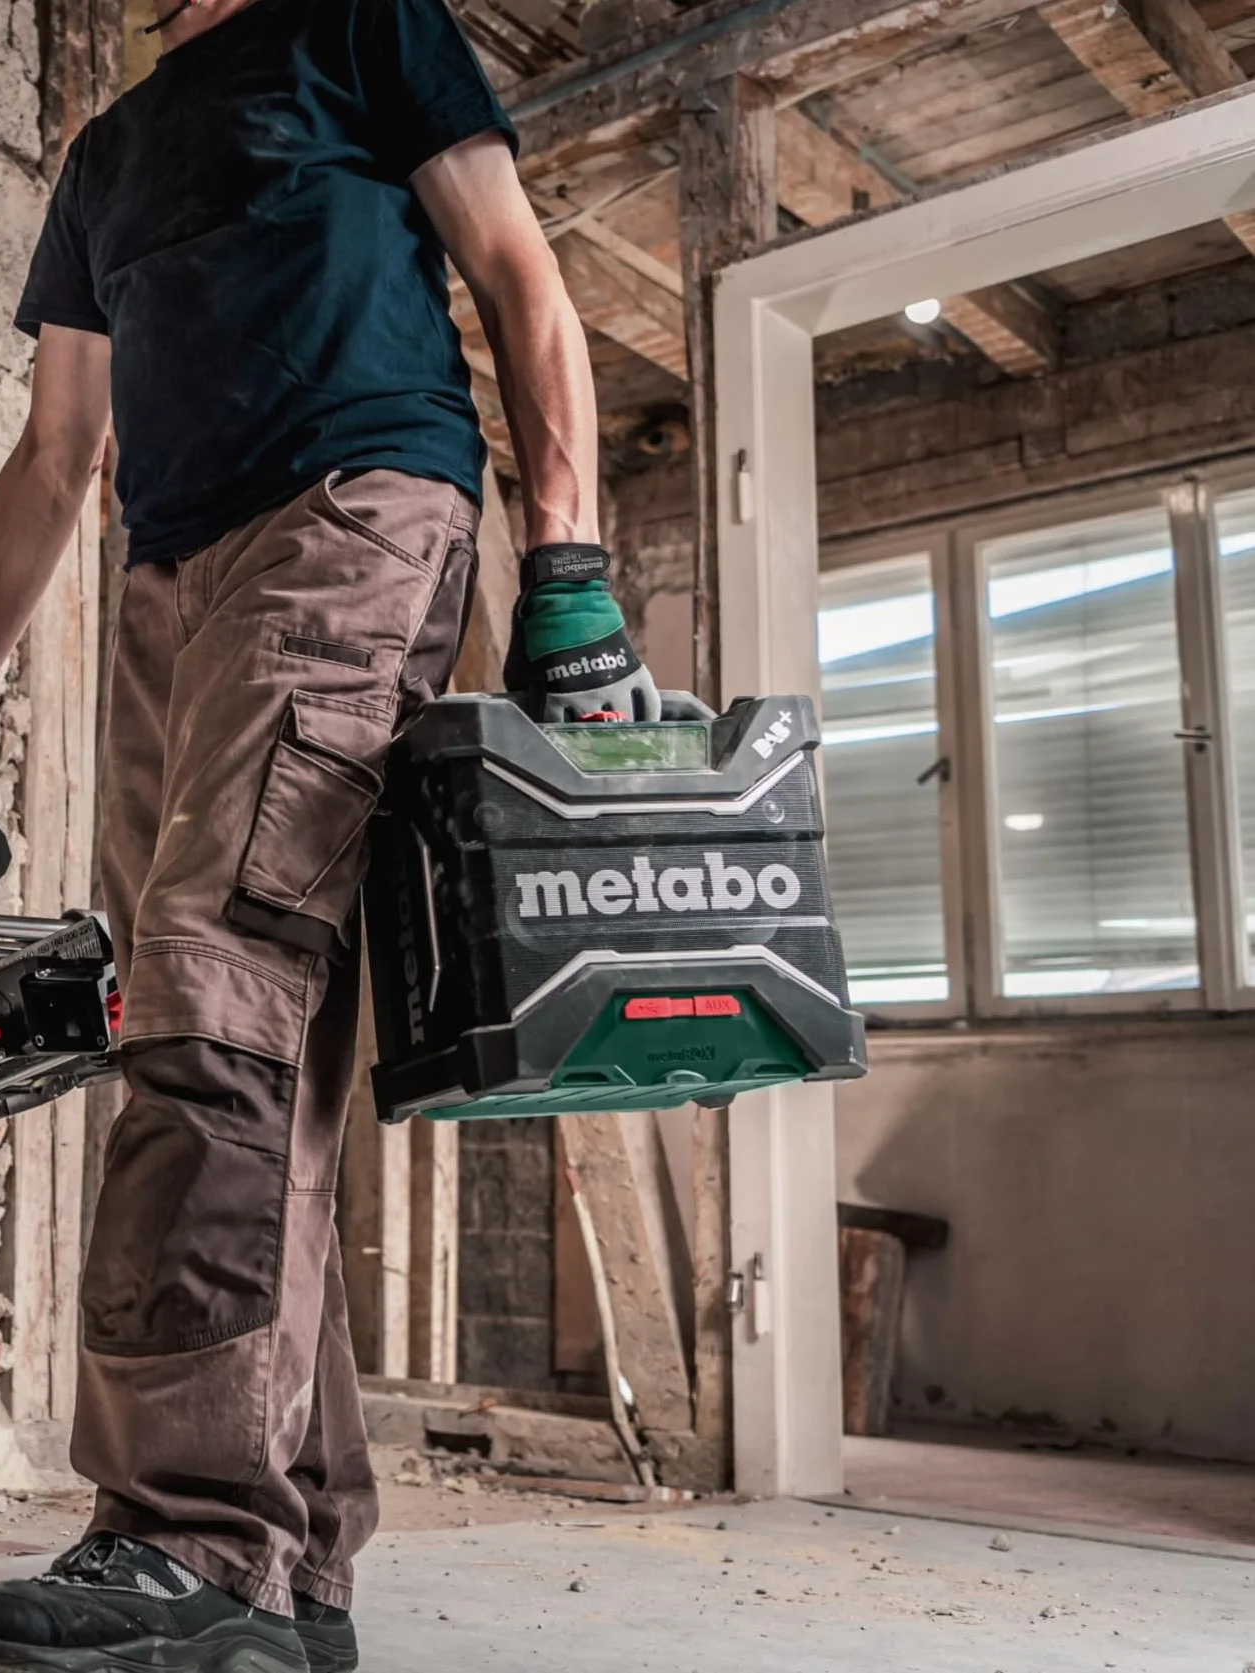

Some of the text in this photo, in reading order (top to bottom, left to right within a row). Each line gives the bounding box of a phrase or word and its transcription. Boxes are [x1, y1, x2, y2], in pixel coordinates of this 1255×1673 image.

[545, 652, 627, 682] metabo
[515, 852, 802, 918] metabo
[78, 922, 94, 936] 220
[705, 999, 731, 1011] AUX
